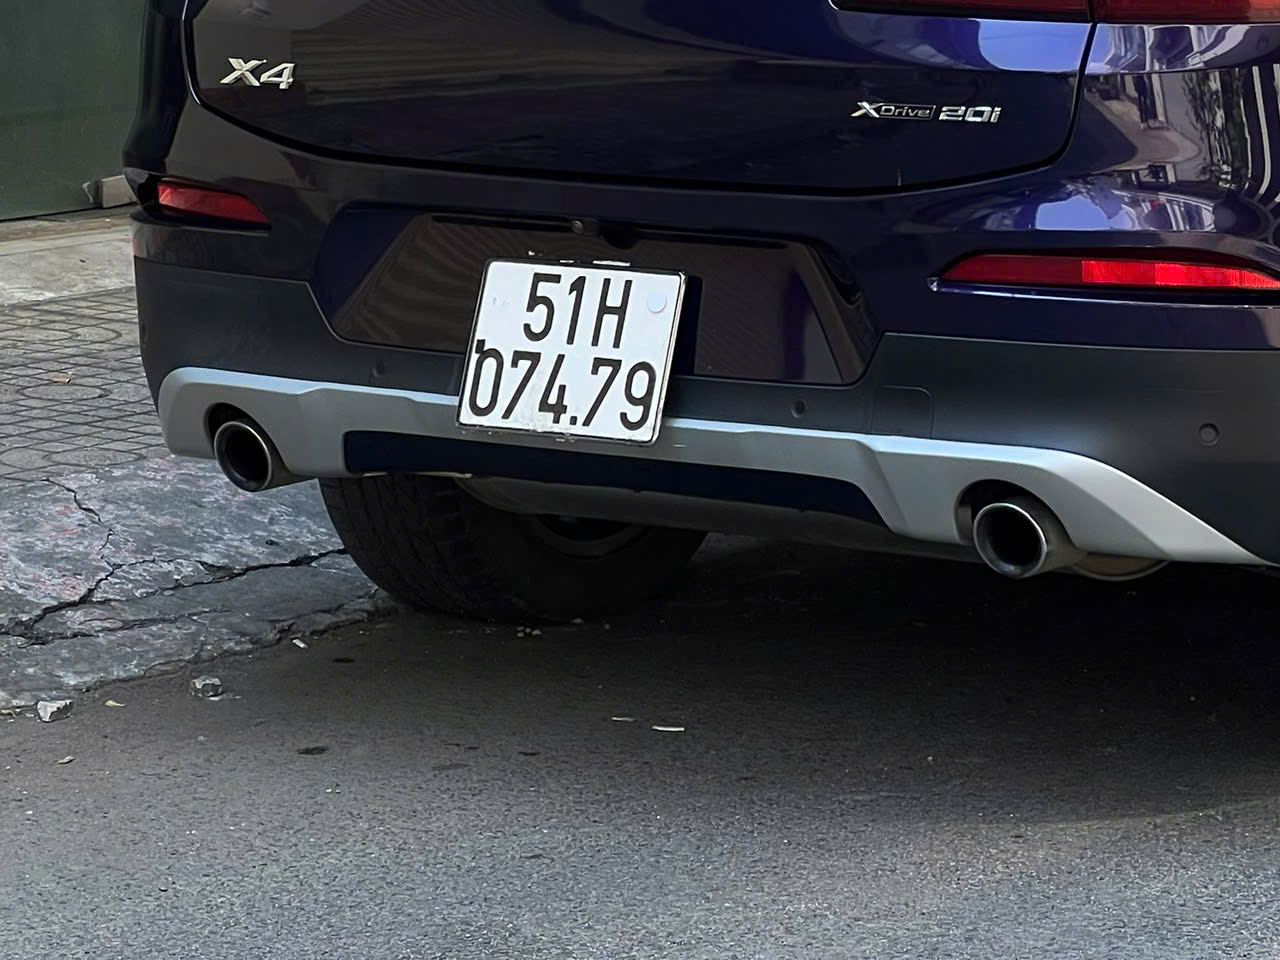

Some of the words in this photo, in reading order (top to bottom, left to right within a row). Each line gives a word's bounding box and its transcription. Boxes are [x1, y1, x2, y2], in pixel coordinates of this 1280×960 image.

[220, 57, 296, 90] X4
[938, 105, 1002, 123] 20i
[522, 272, 633, 349] 51H
[468, 344, 657, 431] 074.79
